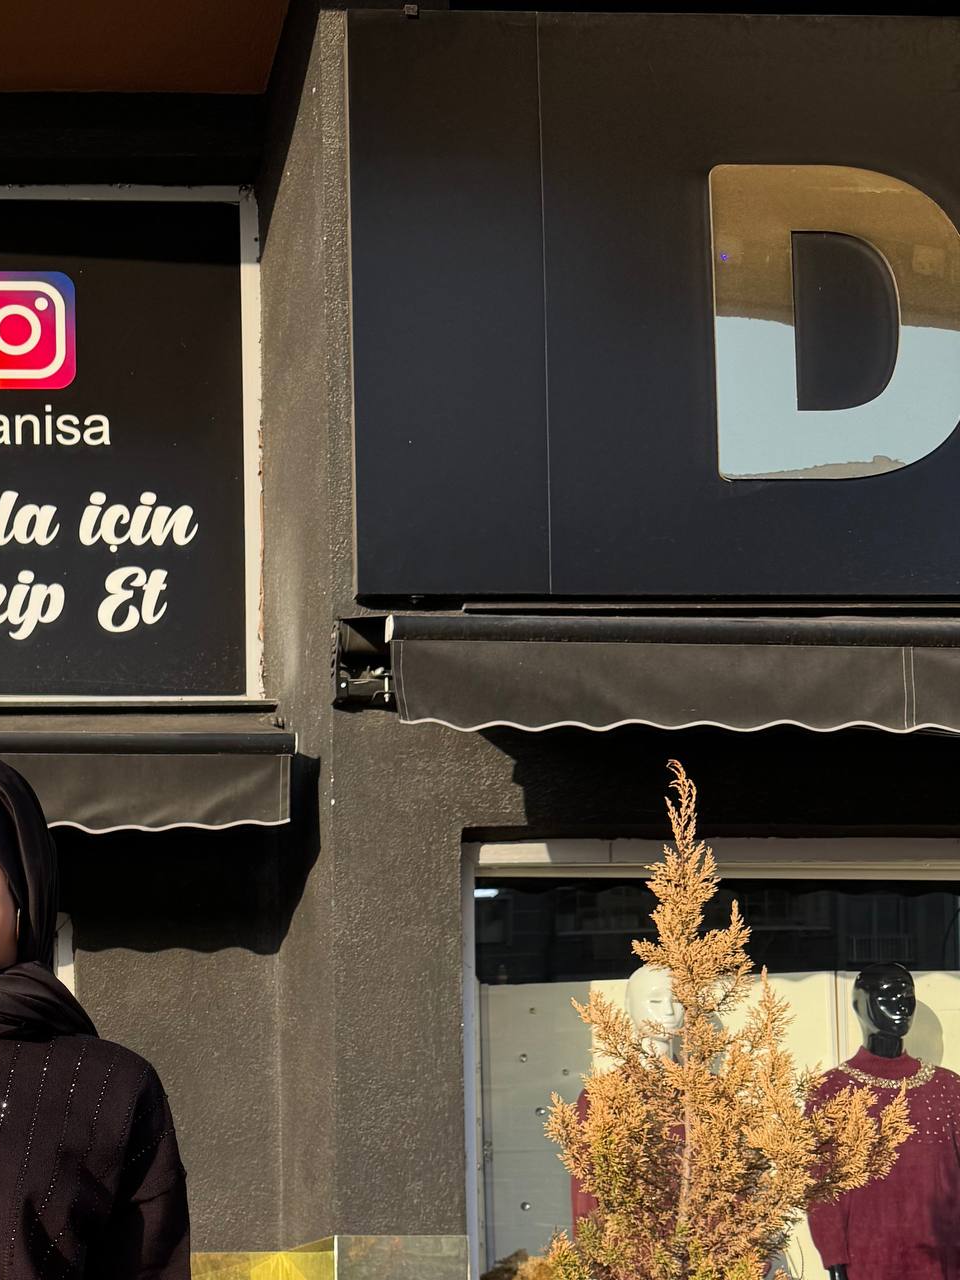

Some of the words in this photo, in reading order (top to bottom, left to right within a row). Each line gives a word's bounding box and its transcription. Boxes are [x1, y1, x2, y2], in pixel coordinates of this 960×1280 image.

[710, 164, 960, 481] D
[78, 491, 200, 553] için
[96, 566, 169, 633] Et
